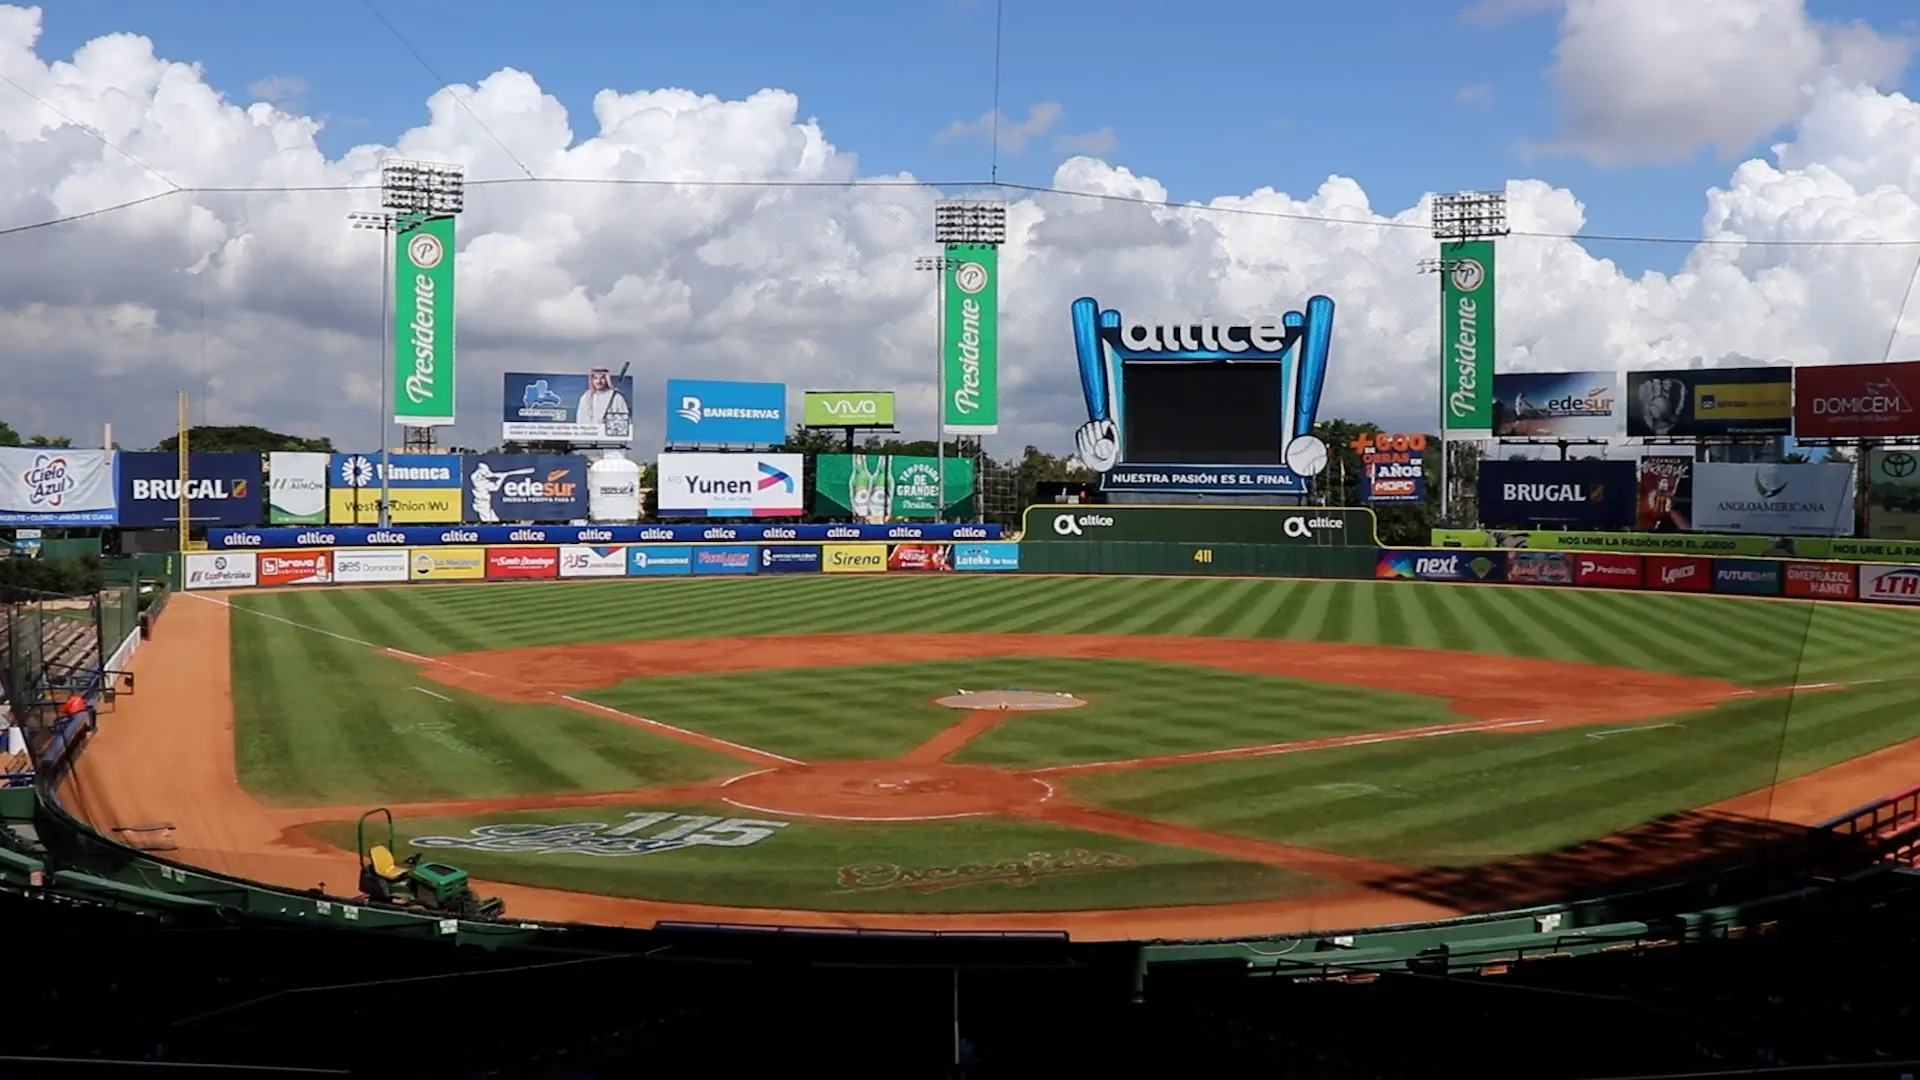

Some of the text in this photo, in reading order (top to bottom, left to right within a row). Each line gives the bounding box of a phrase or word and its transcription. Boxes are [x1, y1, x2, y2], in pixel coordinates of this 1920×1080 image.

[405, 273, 435, 404] Presidente
[954, 298, 980, 415] Presidente
[1450, 296, 1477, 418] Presidente
[1549, 395, 1615, 411] edesur
[1812, 396, 1900, 415] DOMICEM
[703, 407, 781, 420] BANRESERVAS
[31, 465, 65, 484] Cielo
[1112, 471, 1293, 486] NUESTRA PASIÓN ES EL FINAL
[1378, 463, 1422, 478] AÑOS
[33, 478, 65, 499] Azul
[132, 479, 229, 500] BRUGAL
[503, 477, 577, 497] edesur
[684, 475, 752, 494] Yunen
[1503, 483, 1587, 502] BRUGAL
[1717, 501, 1826, 513] ANGLOAMERICANA
[1079, 514, 1114, 527] altice
[1308, 516, 1344, 528] altice
[224, 526, 987, 545] altice altice altice altice altice altice altice altice altice altice altice altice
[1558, 536, 1581, 545] NOS
[1605, 538, 1619, 546] LA
[1662, 539, 1685, 548] POR
[833, 552, 881, 566] Sirena
[1194, 550, 1213, 563] 411
[1415, 554, 1459, 574] next
